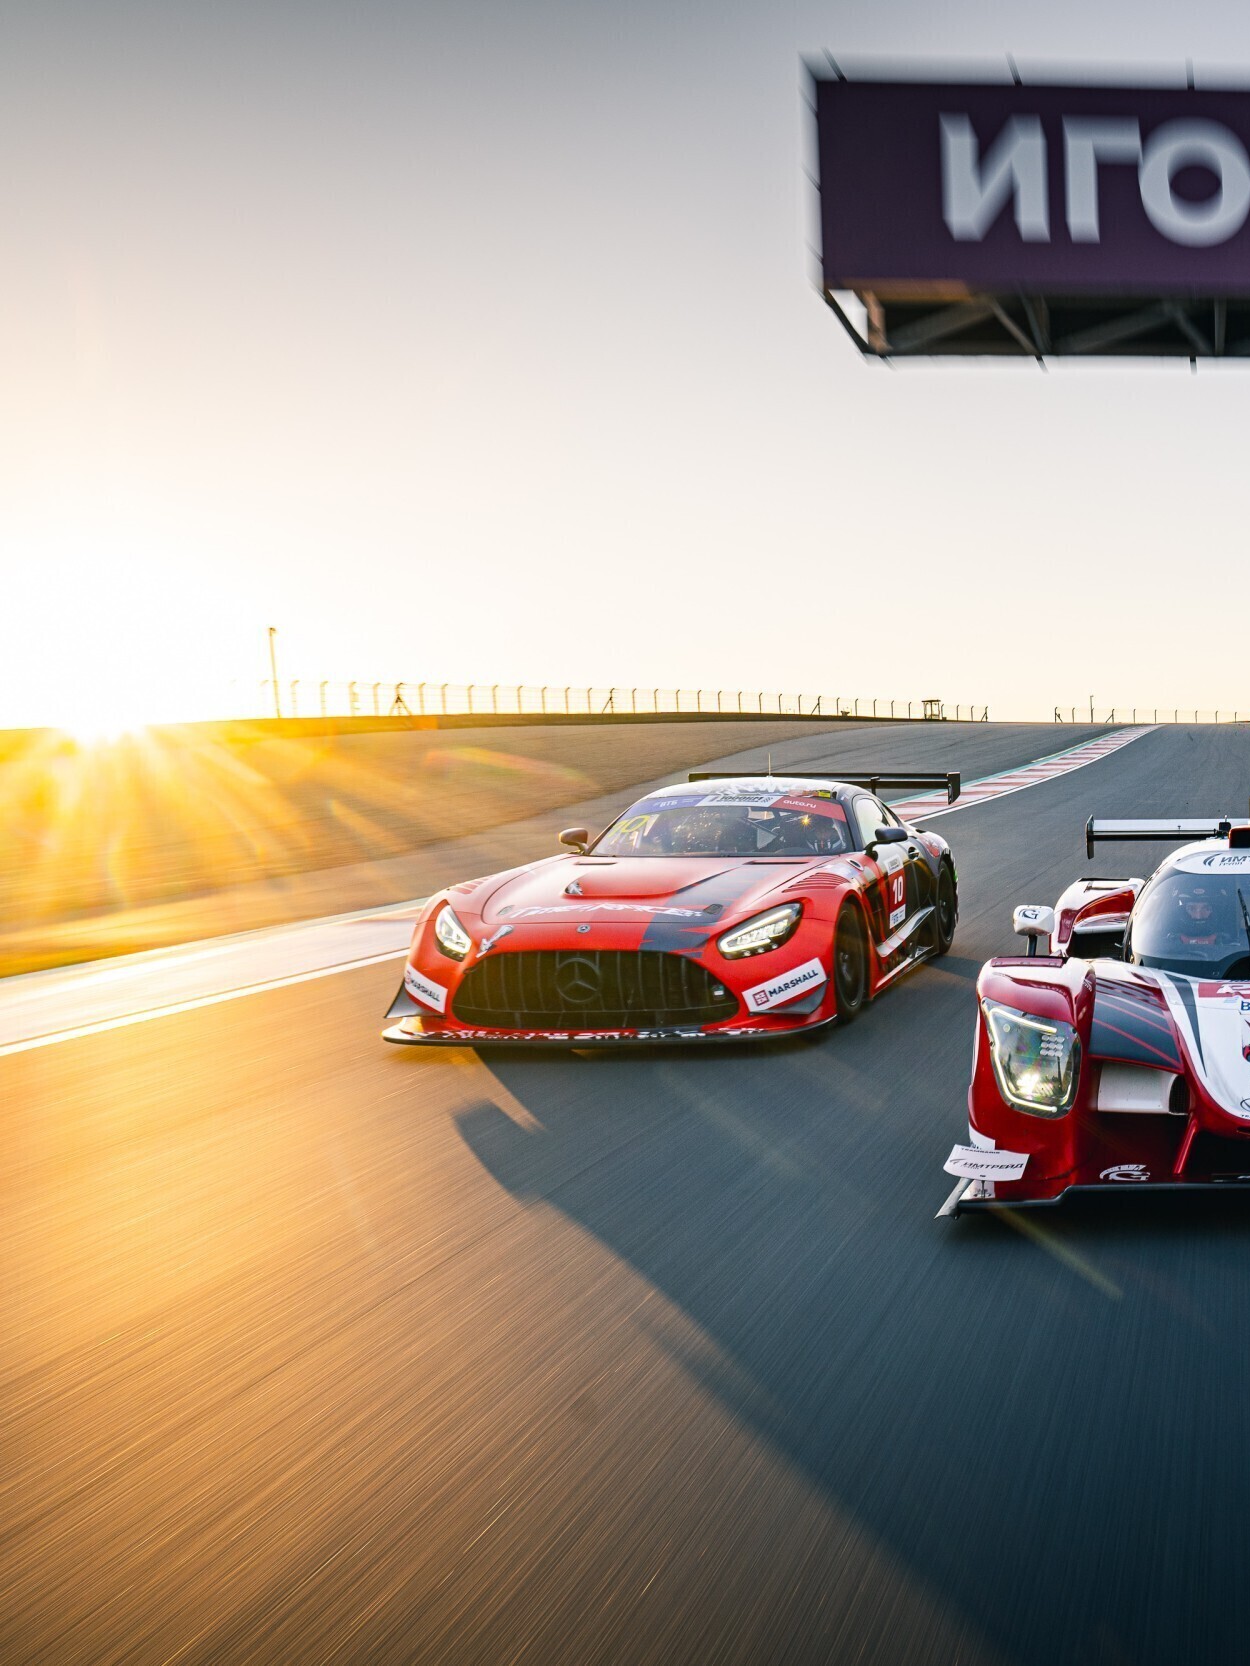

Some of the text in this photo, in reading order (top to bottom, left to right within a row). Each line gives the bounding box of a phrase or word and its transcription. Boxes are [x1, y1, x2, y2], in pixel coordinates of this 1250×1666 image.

[783, 799, 817, 809] auto.ru
[892, 875, 905, 905] 10
[768, 969, 819, 998] MARSHALL
